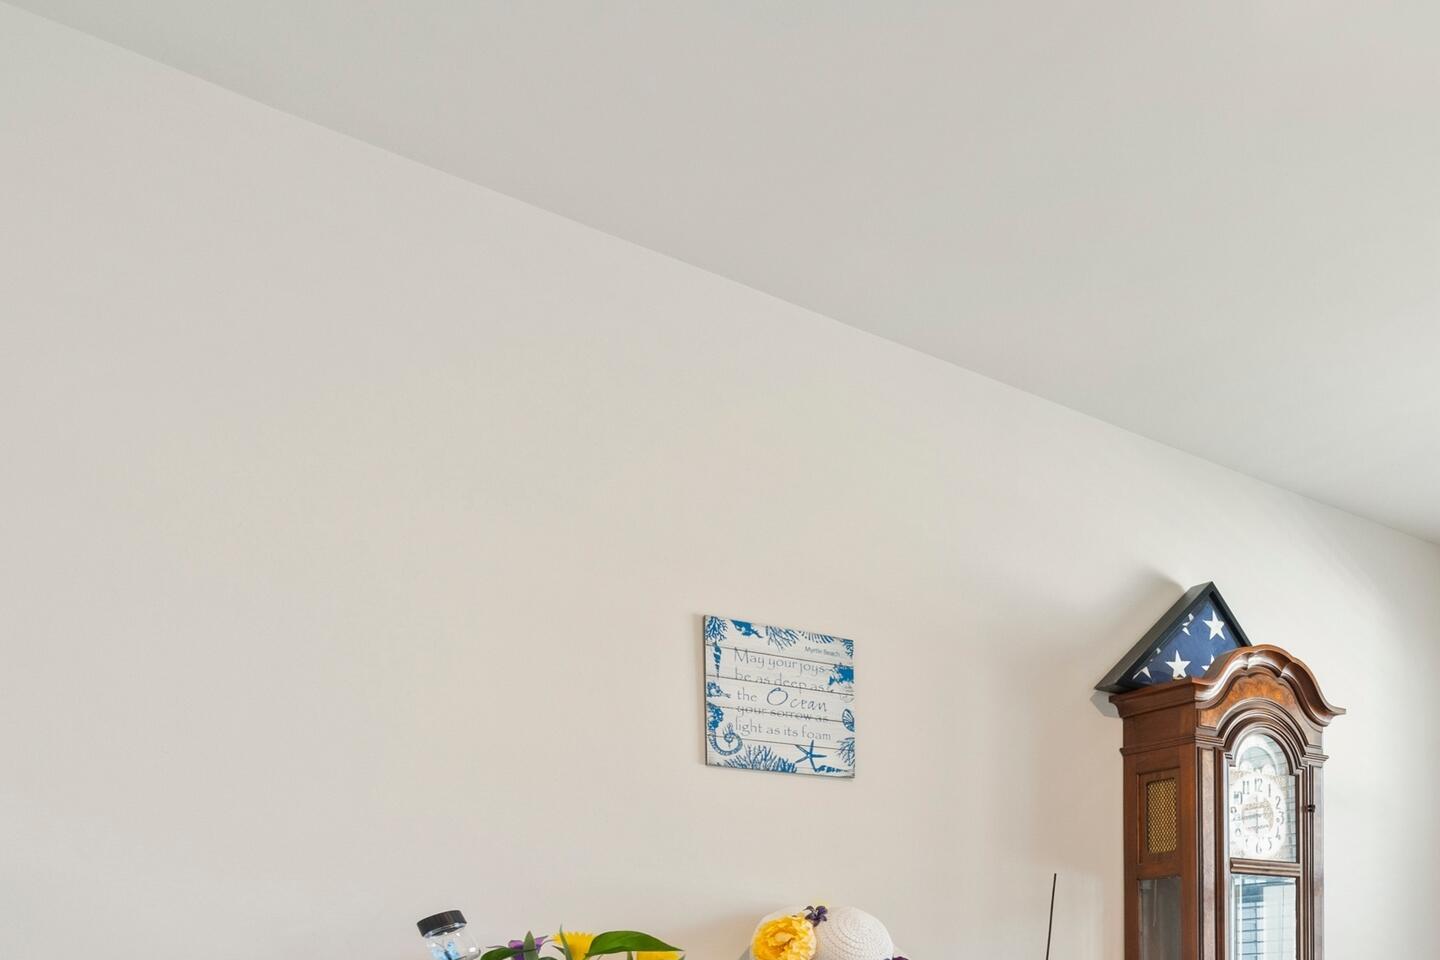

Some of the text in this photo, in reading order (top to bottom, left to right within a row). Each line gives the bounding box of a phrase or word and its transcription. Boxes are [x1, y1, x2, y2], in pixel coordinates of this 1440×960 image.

[734, 647, 826, 675] May your joys
[735, 667, 752, 680] be
[774, 672, 806, 694] deep
[737, 687, 828, 713] the Ocean
[737, 704, 767, 718] your
[770, 708, 812, 721] sorrow
[735, 717, 832, 741] light as its foam
[1254, 778, 1263, 793] 12
[1275, 795, 1281, 809] 2
